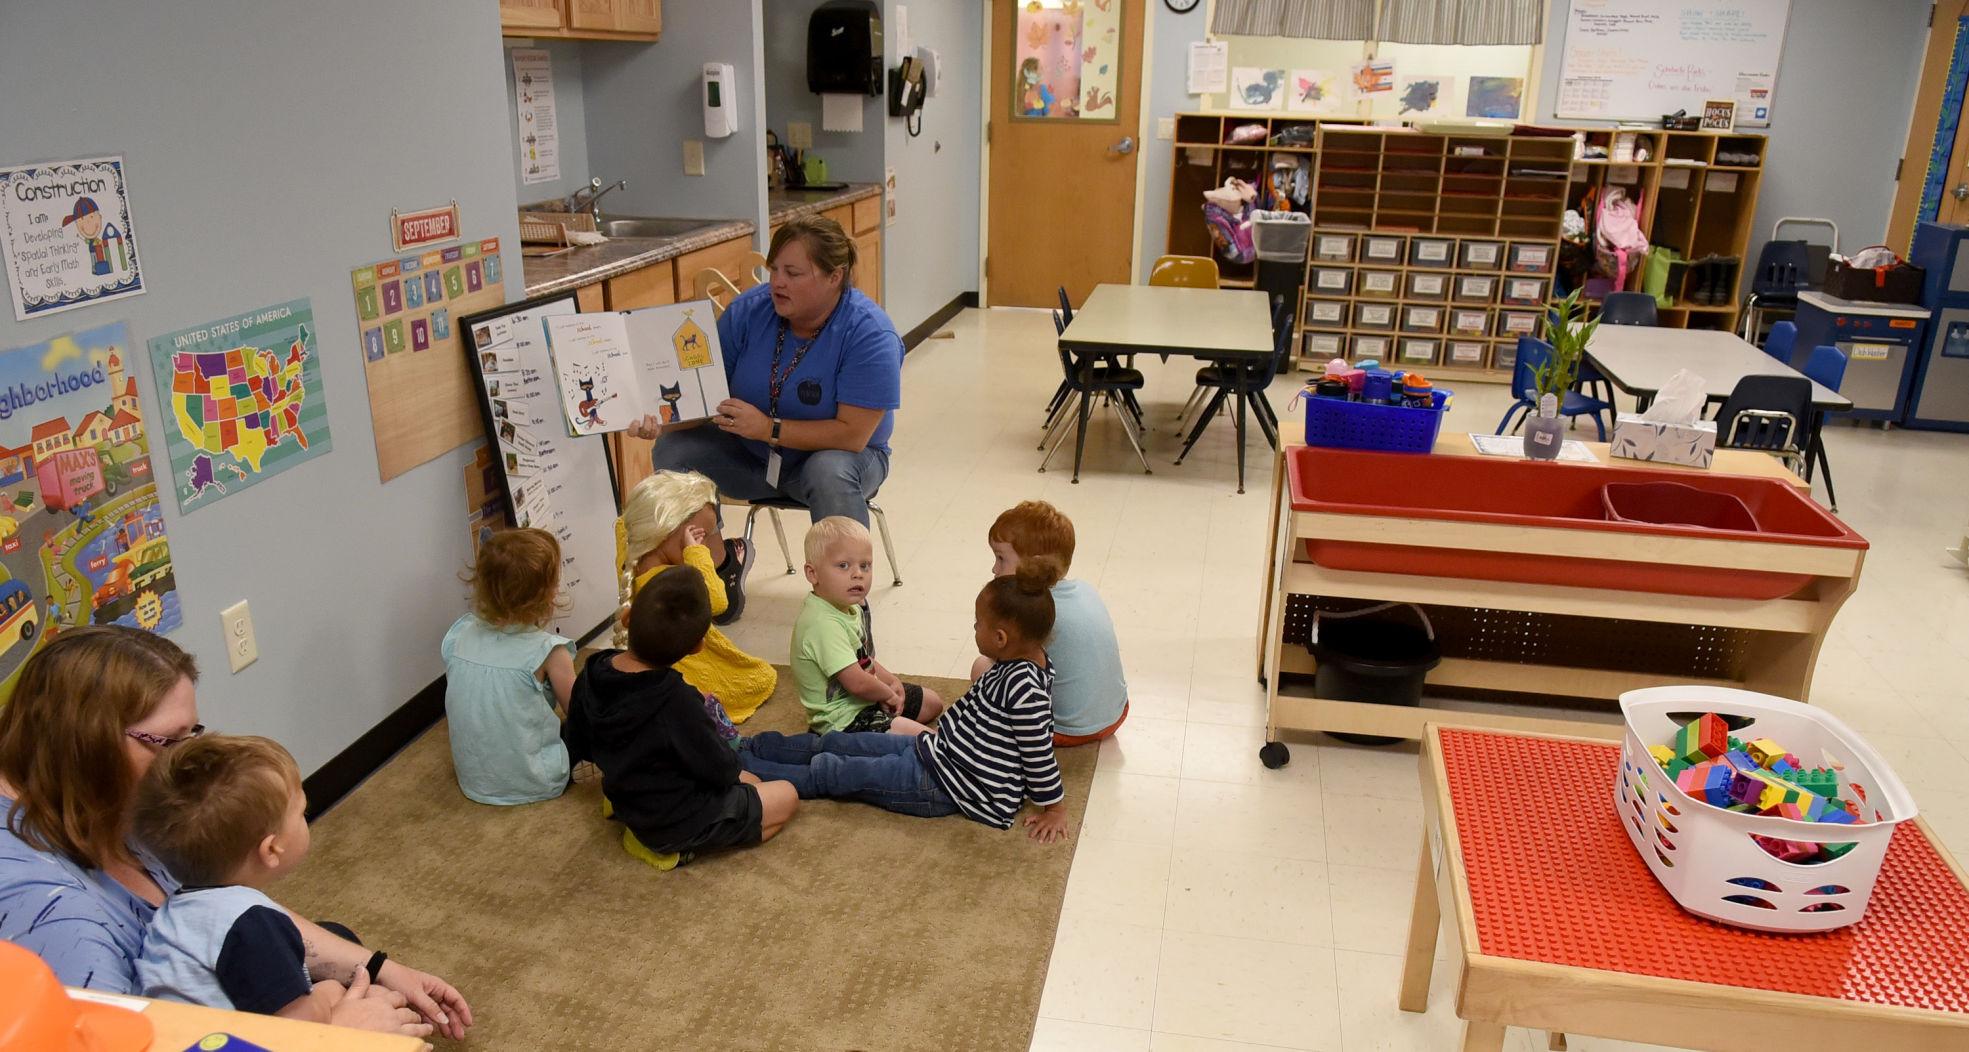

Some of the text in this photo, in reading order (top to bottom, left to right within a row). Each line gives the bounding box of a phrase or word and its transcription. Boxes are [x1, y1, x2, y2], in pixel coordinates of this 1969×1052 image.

[1706, 107, 1732, 118] HOCUS
[1703, 118, 1729, 129] POCUS
[15, 179, 107, 201] Construction
[23, 227, 64, 244] Developing
[403, 214, 450, 241] SEPTEMBER
[21, 249, 49, 264] Spatial
[25, 258, 80, 278] and Early Math
[365, 262, 495, 312] 1 2 3 4 5 6 7
[174, 307, 292, 348] UNITED STATES OF AMERICA
[371, 316, 445, 353] 8 9 10 11
[59, 452, 97, 474] MAX'S
[132, 463, 147, 474] truck
[69, 471, 95, 487] moving
[73, 482, 94, 495] truck
[4, 539, 18, 551] taxi
[90, 556, 107, 569] ferry
